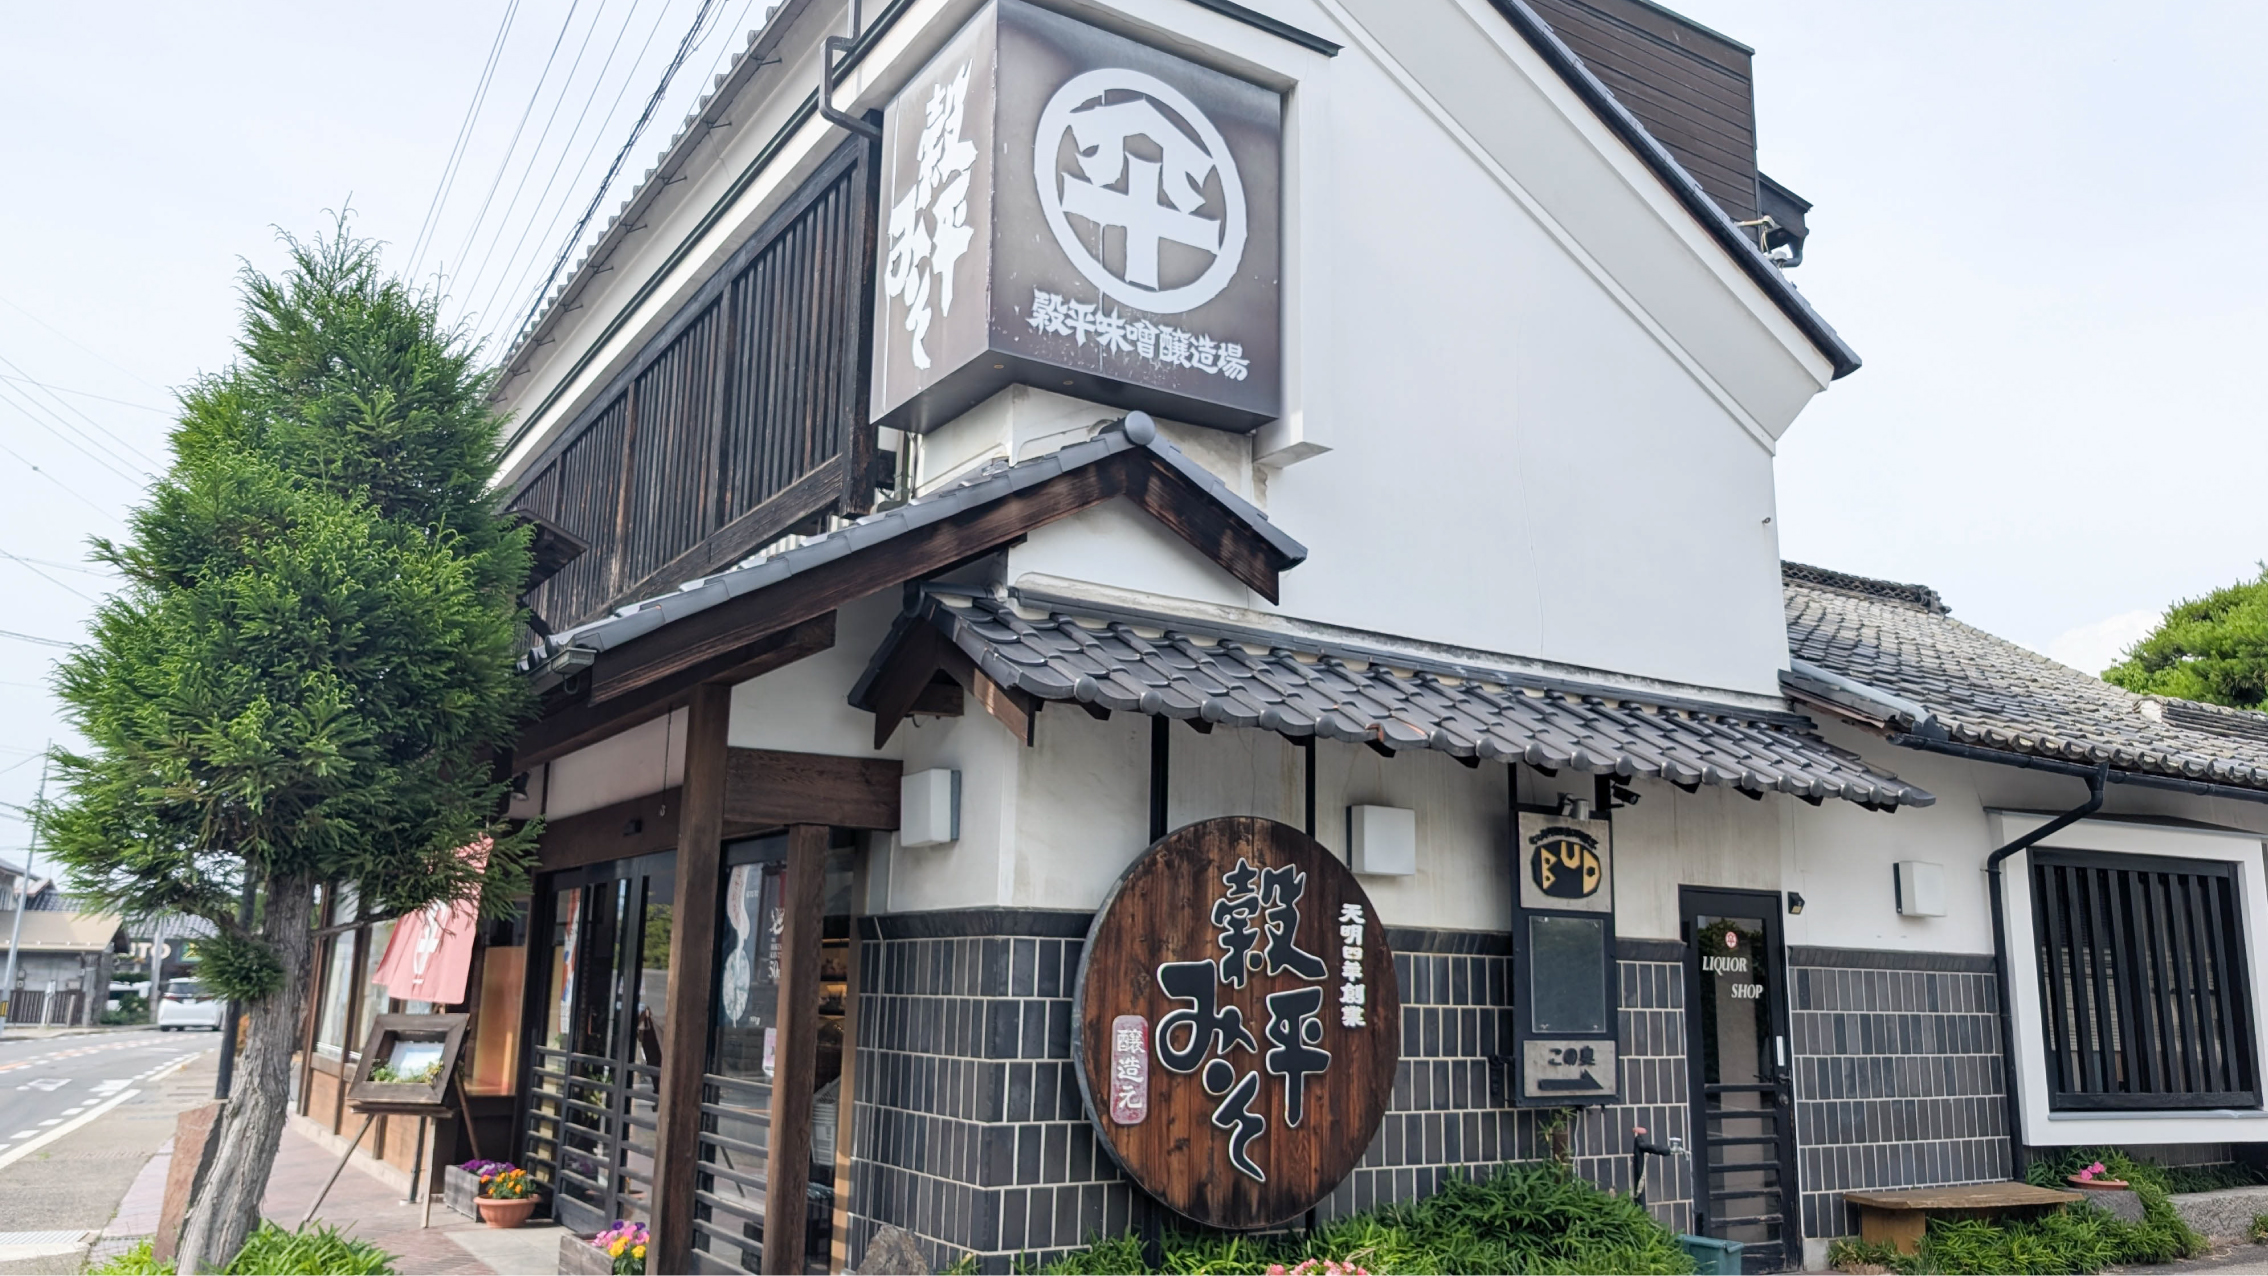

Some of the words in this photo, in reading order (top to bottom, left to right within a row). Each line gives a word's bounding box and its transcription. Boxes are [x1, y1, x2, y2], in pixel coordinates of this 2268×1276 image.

[1338, 902, 1367, 1029] 天明四年創業
[1702, 955, 1748, 977] LIQUOR
[1731, 983, 1764, 999] SHOP
[1116, 1028, 1146, 1110] 醸造元
[1154, 958, 1266, 1182] みそ
